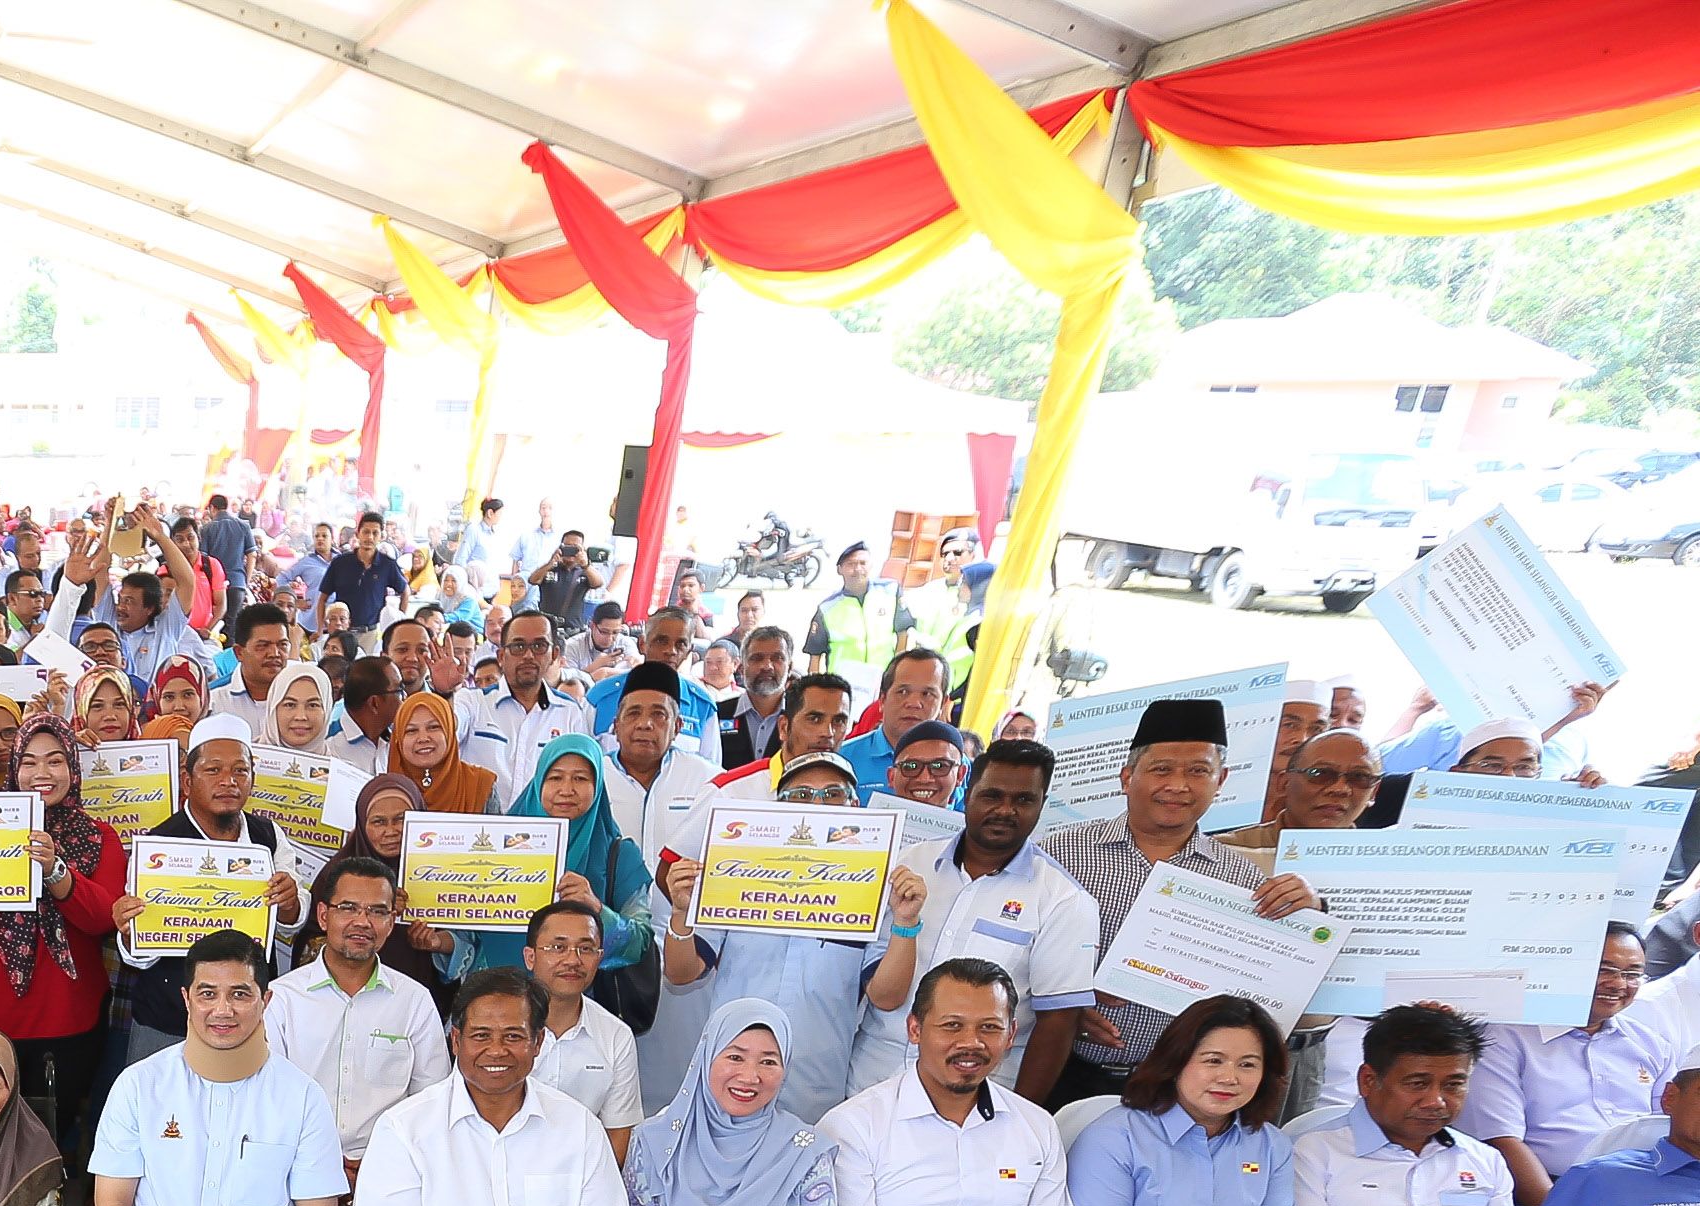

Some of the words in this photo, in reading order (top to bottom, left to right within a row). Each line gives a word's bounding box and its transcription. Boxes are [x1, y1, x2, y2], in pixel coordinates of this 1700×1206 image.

[1068, 705, 1103, 720] MENTERI
[1105, 701, 1130, 714] BESAR
[1056, 744, 1095, 757] SUMBANGAN
[1095, 739, 1123, 750] SEMPENA
[1107, 745, 1130, 755] KEPAD
[1109, 753, 1127, 762] DAER
[107, 787, 164, 804] Kasih
[1109, 789, 1122, 798] RIB
[1434, 786, 1474, 798] MENTERI
[1476, 789, 1502, 802] BESAR
[1504, 791, 1553, 805] SELANGOR
[1555, 795, 1632, 810] PEMERBADANAN
[252, 808, 317, 827] KERAJAAN
[282, 826, 339, 845] ELANGOR
[1305, 846, 1351, 856] MENTERI
[1356, 846, 1388, 856] BESAR
[1391, 846, 1451, 856] SELANGOR
[1452, 845, 1549, 857] PEMERBADANAN
[409, 865, 477, 882] Terima
[484, 867, 547, 883] Kasih
[710, 859, 792, 879] Terima
[799, 864, 877, 883] Kasih
[145, 888, 202, 904] Terima
[207, 891, 263, 908] Kasih
[437, 894, 516, 903] KERAJAAN
[741, 891, 836, 905] KERAJAAN
[1176, 883, 1227, 907] KERAJAAN
[406, 908, 460, 918] NEGERI
[465, 909, 534, 919] SELANGO
[701, 907, 767, 920] NEGERI
[773, 911, 871, 925] SELANGOR
[1363, 905, 1399, 913] DAERAH
[1402, 905, 1439, 913] SEPANG
[1442, 905, 1466, 913] OLEH
[164, 917, 233, 928] KERAJAAN
[1336, 914, 1376, 922] MENTERI
[1379, 914, 1410, 922] BESAR
[1413, 914, 1464, 922] SELANGOR
[137, 932, 182, 942] NEGERI
[1340, 947, 1358, 956] LUH
[1359, 947, 1382, 956] RIBU
[1385, 947, 1420, 956] SAHAJA
[1522, 946, 1572, 955] 20,000.00
[1163, 970, 1210, 992] Selangor
